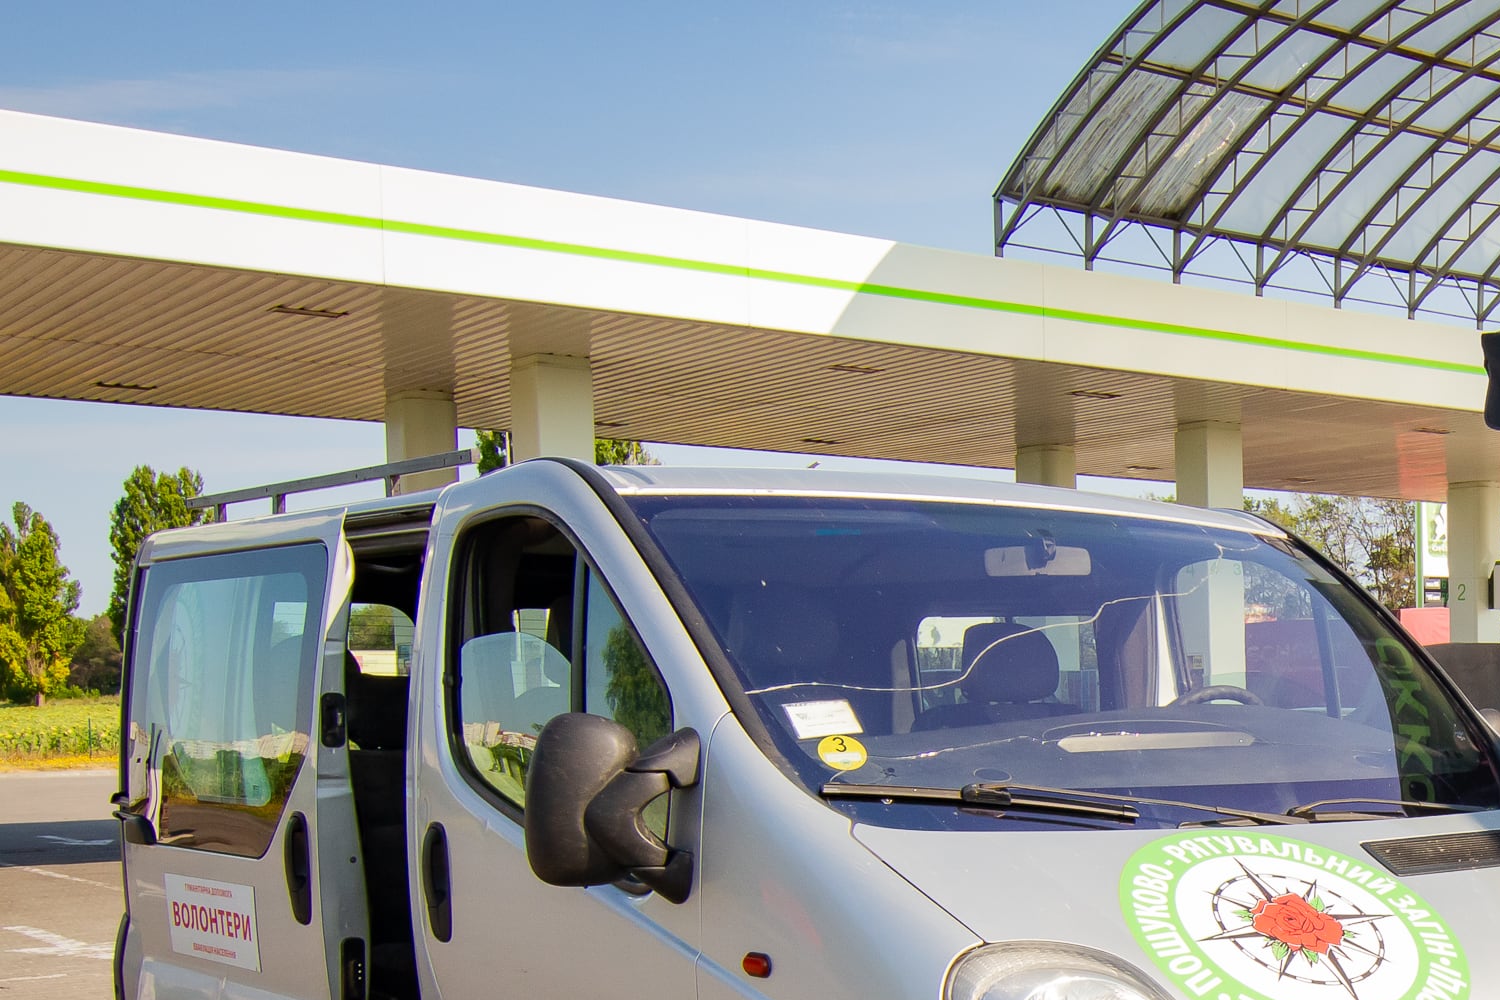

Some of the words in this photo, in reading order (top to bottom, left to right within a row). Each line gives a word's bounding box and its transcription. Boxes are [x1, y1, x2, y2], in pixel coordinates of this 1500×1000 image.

[1457, 583, 1466, 601] 2
[832, 736, 847, 753] 3
[172, 901, 252, 942] ВОЛОНТЕРИ
[1387, 894, 1458, 959] ЗАГІН
